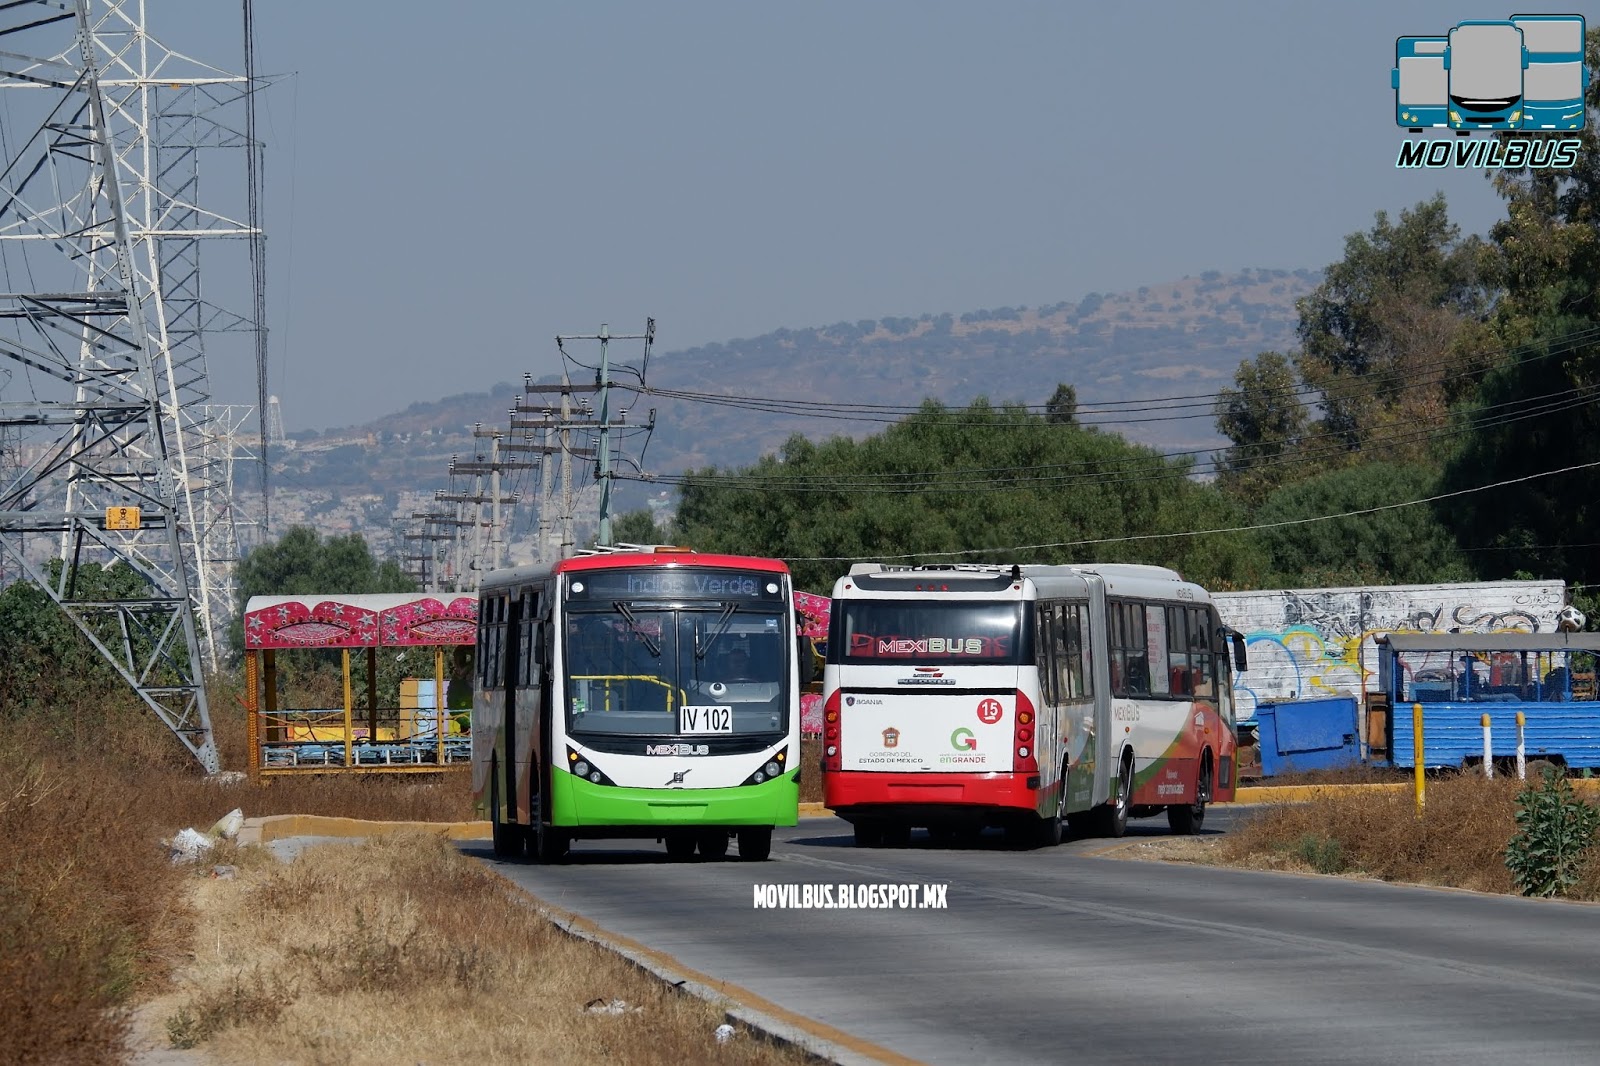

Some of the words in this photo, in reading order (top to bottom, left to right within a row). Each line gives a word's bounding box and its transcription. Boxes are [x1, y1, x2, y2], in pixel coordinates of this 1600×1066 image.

[627, 574, 684, 593] Indios
[878, 638, 982, 654] MEXIBUS
[981, 701, 998, 716] 15
[683, 708, 698, 731] IV
[703, 708, 730, 731] 102
[646, 743, 709, 756] MEXIBUS
